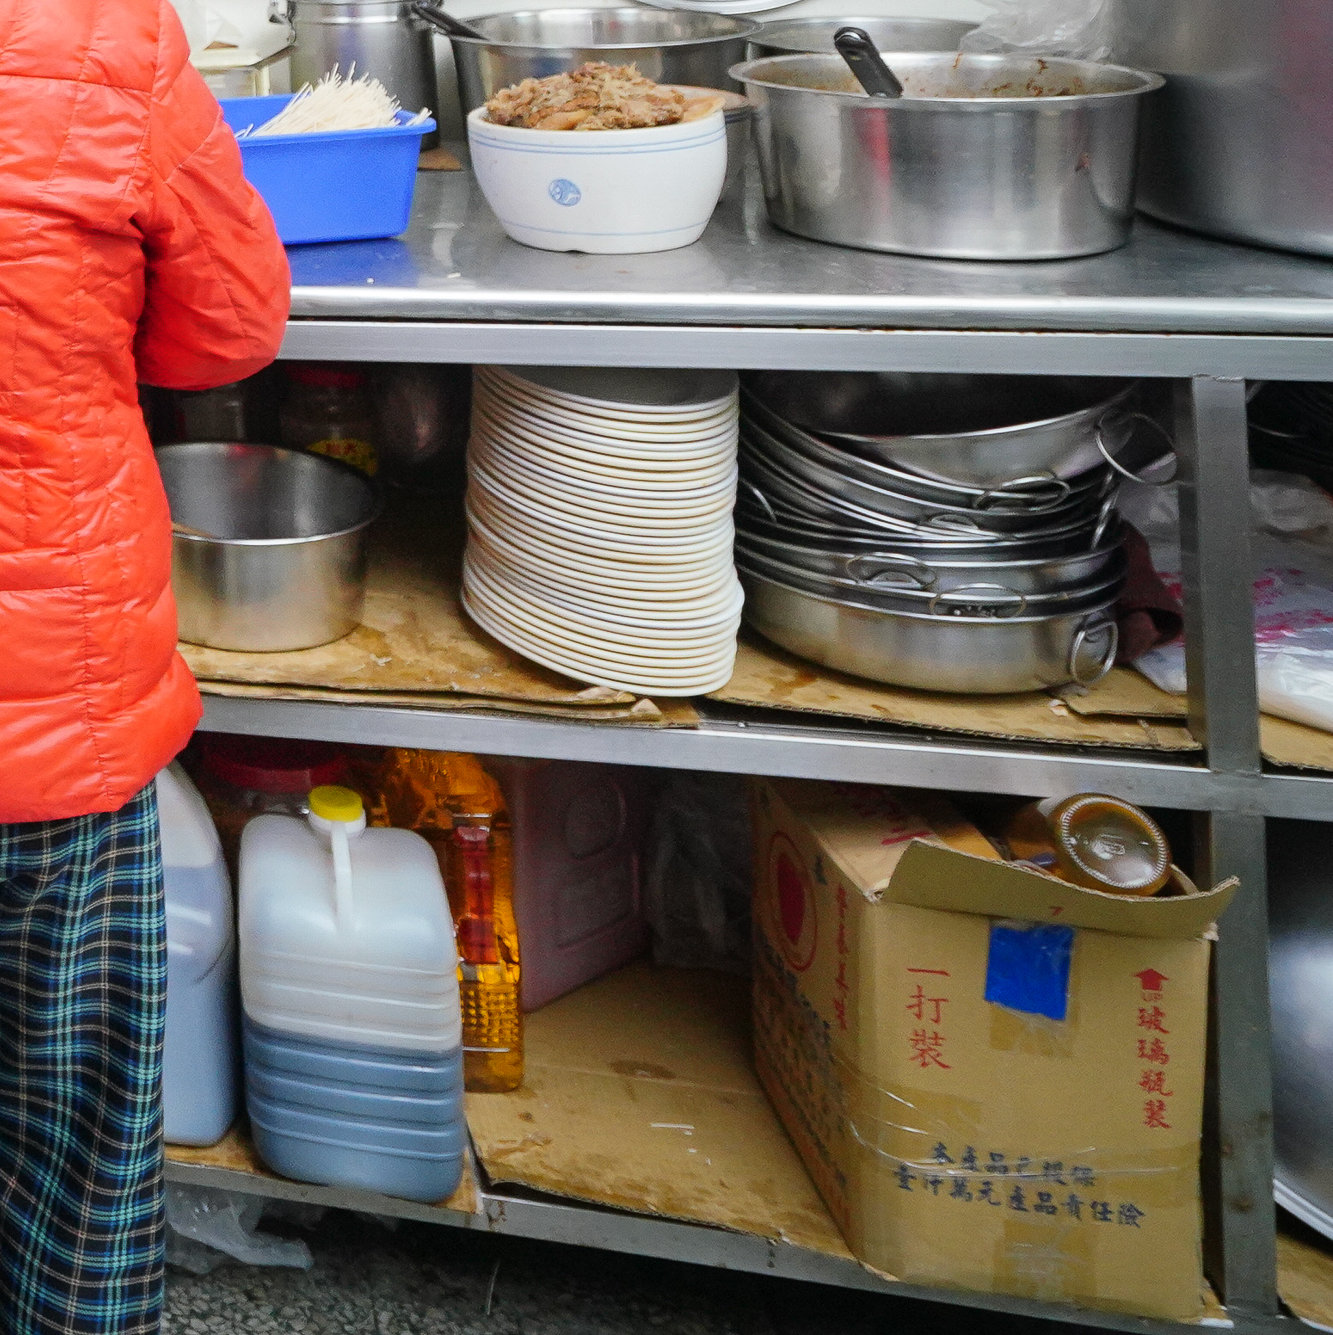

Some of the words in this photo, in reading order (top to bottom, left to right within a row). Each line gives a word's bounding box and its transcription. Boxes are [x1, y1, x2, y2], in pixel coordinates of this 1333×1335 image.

[906, 967, 952, 1070] 一打裝
[1137, 1006, 1174, 1130] 玻璃瓶裝
